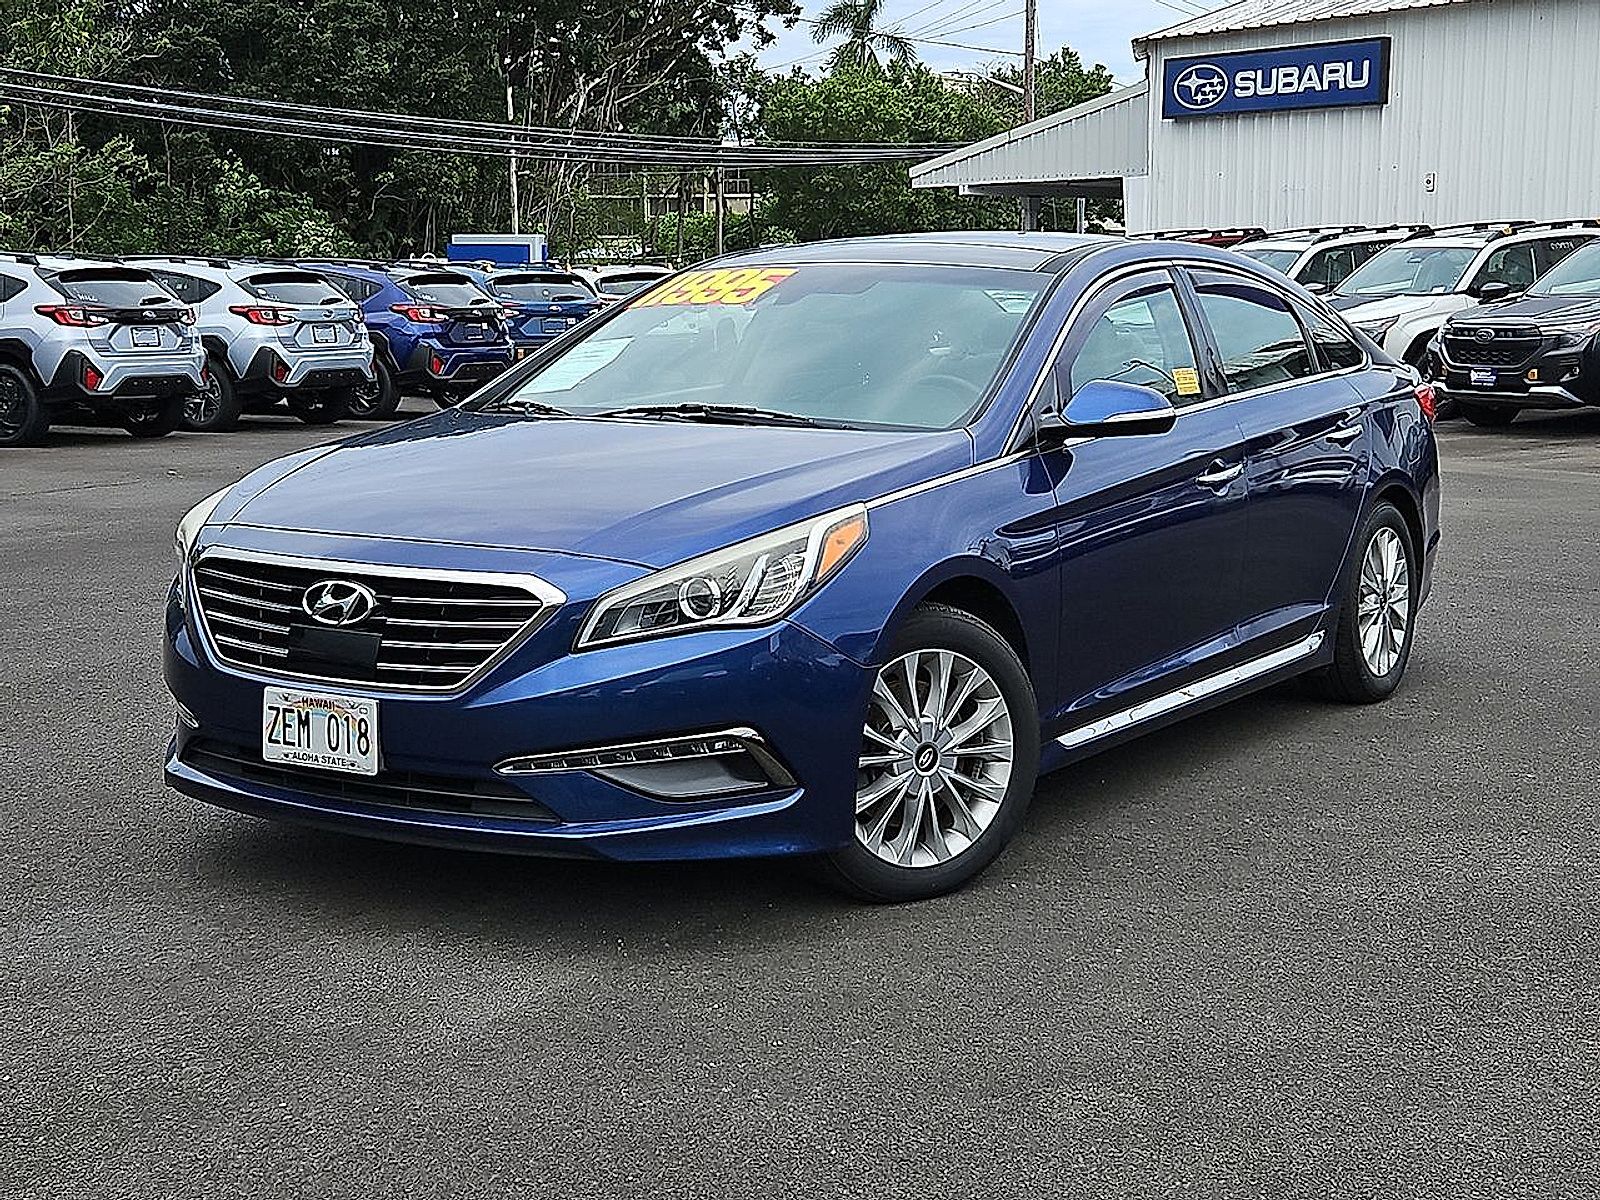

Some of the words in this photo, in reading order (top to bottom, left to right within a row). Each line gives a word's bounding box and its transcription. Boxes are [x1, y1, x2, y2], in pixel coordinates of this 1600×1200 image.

[1234, 60, 1370, 98] SUBARU
[302, 697, 335, 710] HAWAII
[267, 705, 312, 749] ZEM
[327, 713, 370, 756] 018
[292, 752, 319, 763] ALOHA
[321, 755, 347, 766] STATE
